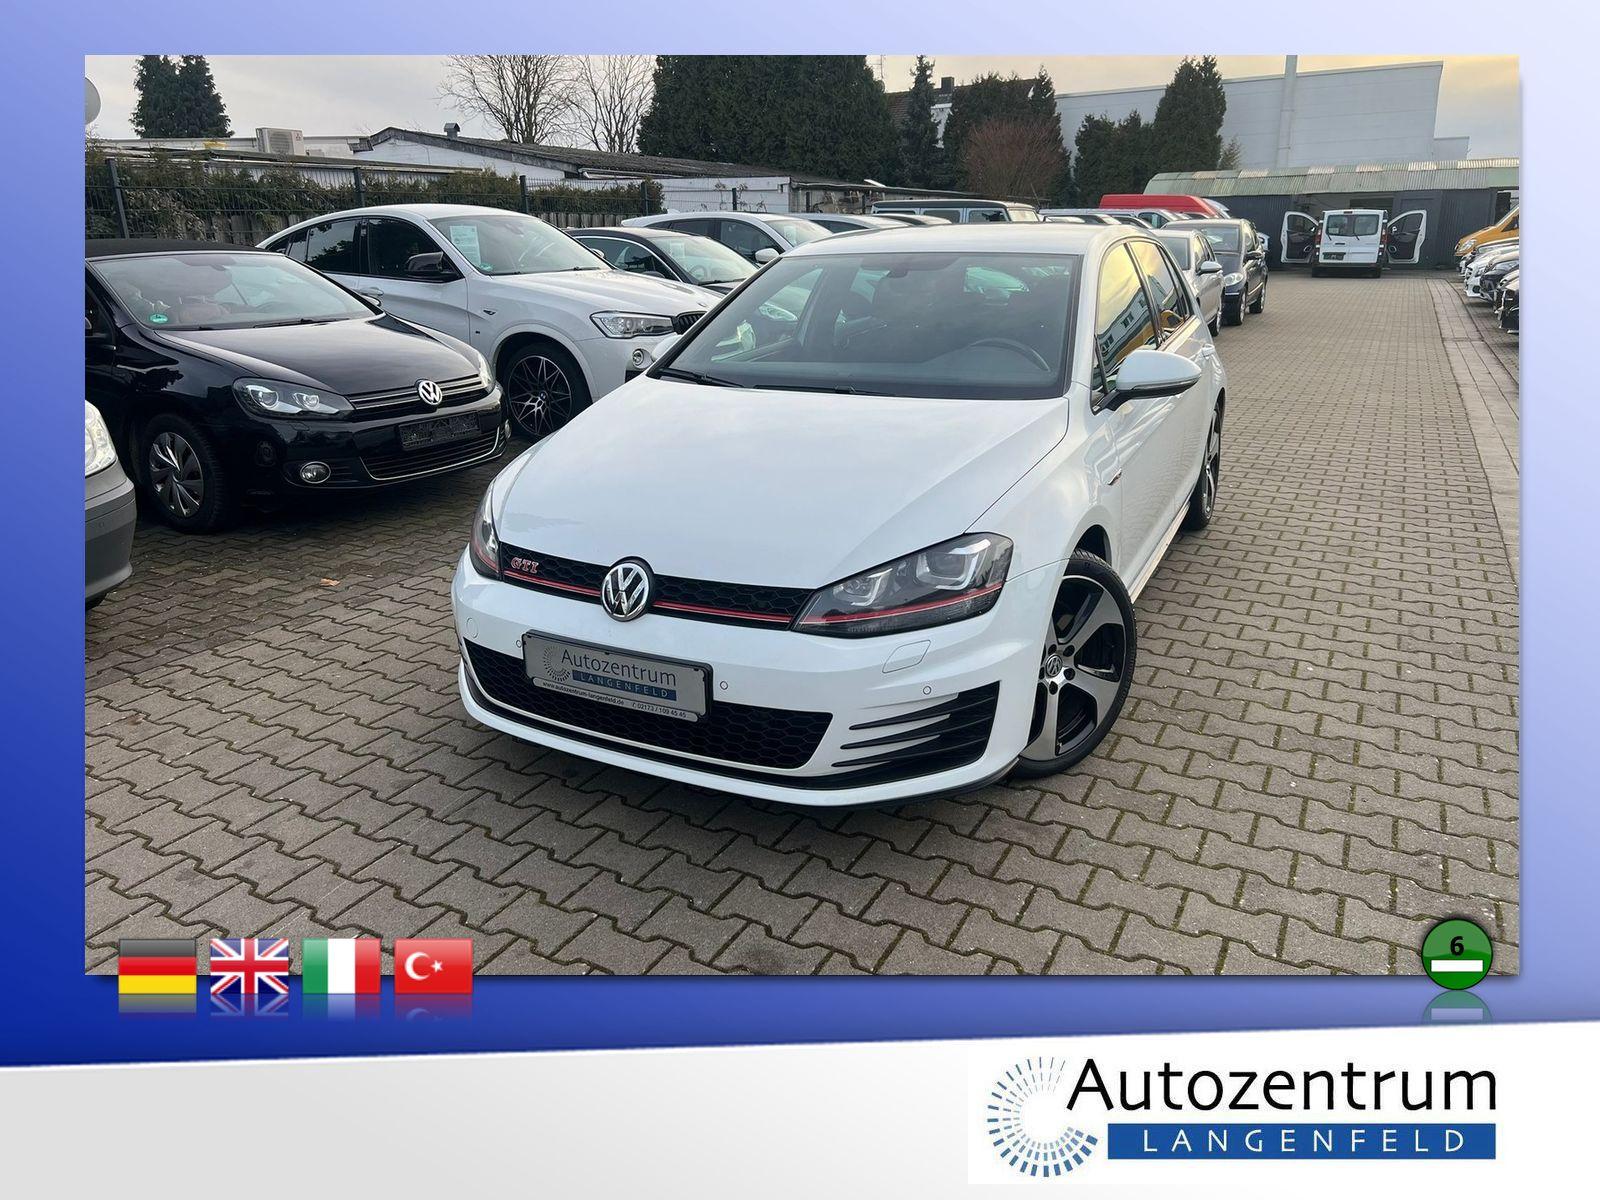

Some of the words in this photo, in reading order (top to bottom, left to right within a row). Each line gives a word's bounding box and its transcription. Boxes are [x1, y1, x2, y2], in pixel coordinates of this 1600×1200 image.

[511, 556, 539, 574] GTI
[602, 562, 649, 617] VW
[561, 649, 676, 687] Autozentrum
[542, 681, 624, 706] www.autozentrum-langenfeld.de
[580, 673, 668, 698] LANGENFELD
